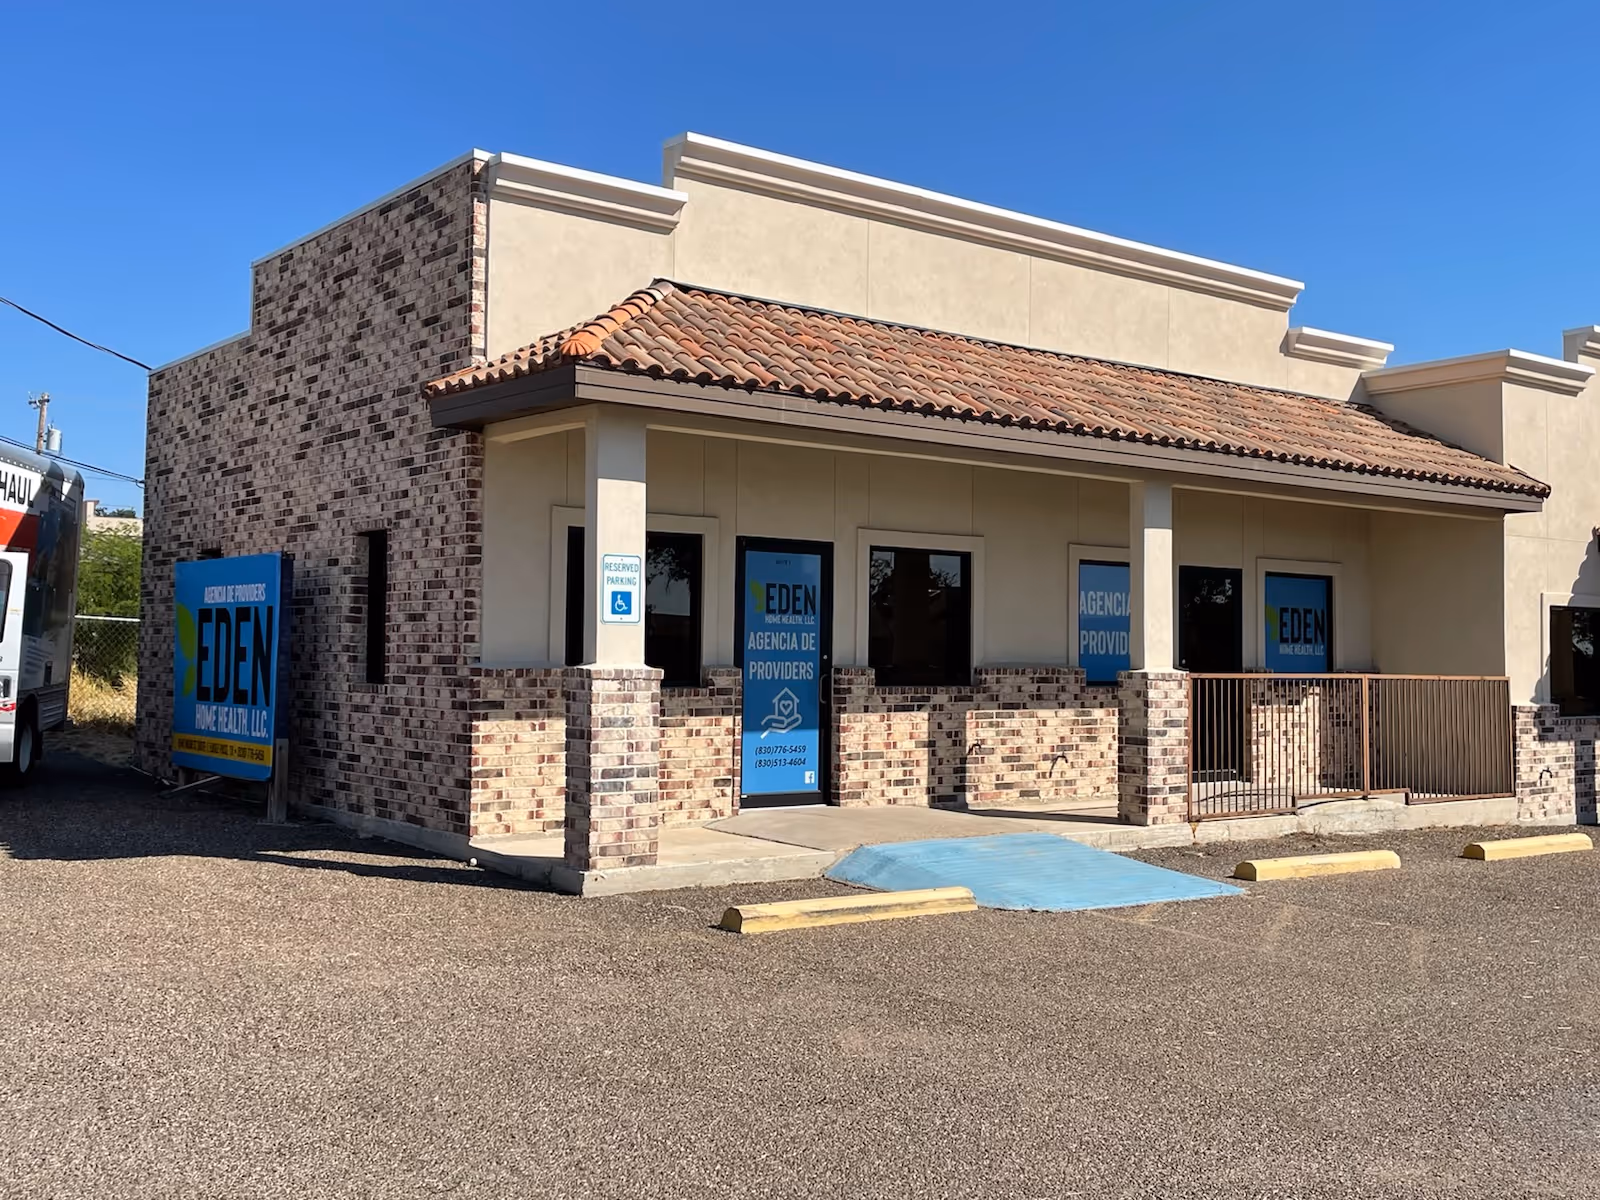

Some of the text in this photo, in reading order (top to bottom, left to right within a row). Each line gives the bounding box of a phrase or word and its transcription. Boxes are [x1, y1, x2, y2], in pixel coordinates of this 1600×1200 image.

[604, 562, 639, 573] RESERVED
[606, 576, 637, 586] PARKING
[227, 585, 234, 603] DE
[235, 583, 266, 602] PROVIDERS
[765, 582, 816, 616] EDEN
[765, 615, 781, 624] HOME
[1279, 607, 1325, 644] EDEN
[747, 631, 816, 651] AGENCIA DE
[1080, 630, 1131, 656] PROVID
[196, 605, 273, 707] EDEN
[749, 660, 814, 681] PROVIDERS
[195, 704, 216, 732] HOME
[755, 745, 806, 756] (830)776-5459
[755, 757, 806, 768] (830)513-4604
